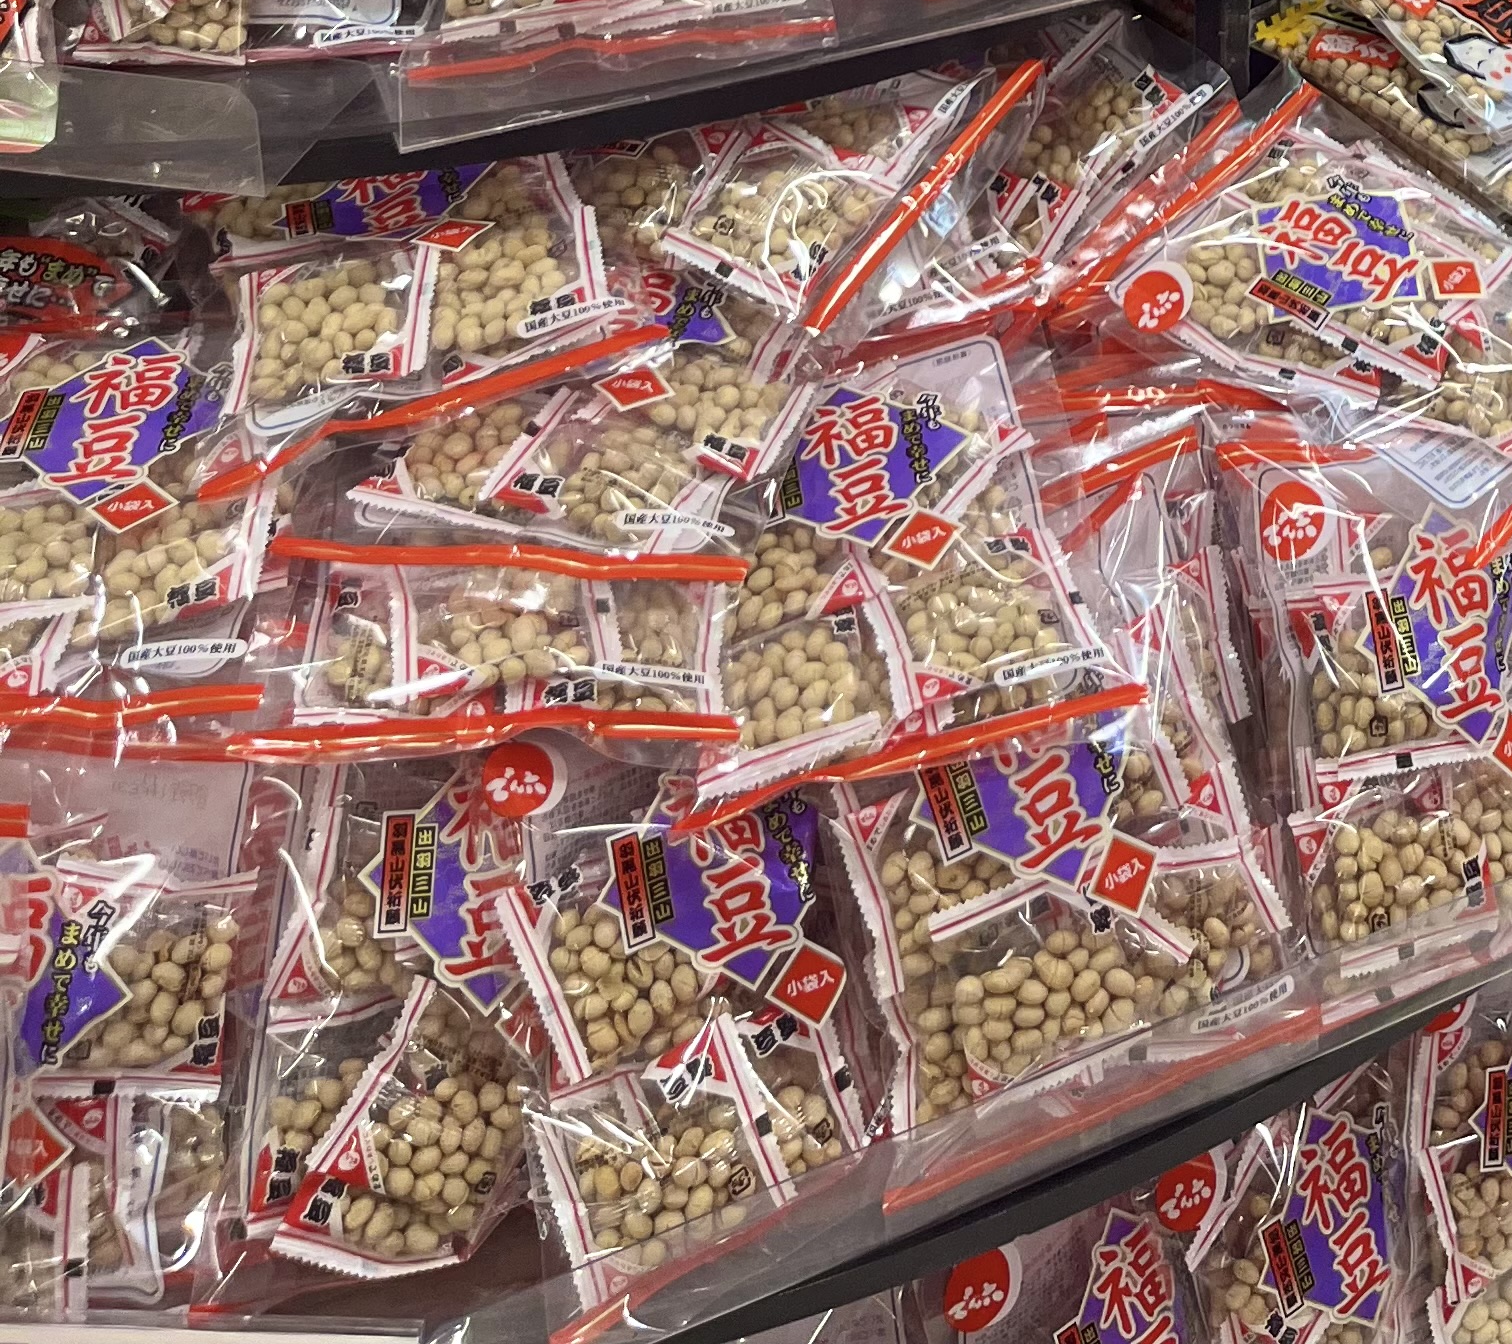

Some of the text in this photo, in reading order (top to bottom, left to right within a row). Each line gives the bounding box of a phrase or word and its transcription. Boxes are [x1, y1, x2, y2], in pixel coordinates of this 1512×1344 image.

[1262, 200, 1420, 304] 福豆
[523, 297, 626, 334] 国産大豆100%使用
[51, 352, 183, 484] 福豆
[900, 407, 933, 484] まめで幸せに
[801, 394, 910, 533] 福豆
[106, 498, 155, 514] 小袋入
[900, 527, 947, 550] 小袋入
[127, 641, 237, 663] 国産大豆100%使用
[1411, 526, 1502, 718] 福豆
[601, 662, 707, 685] 国産大豆100%使用
[1014, 751, 1103, 871] 豆
[414, 826, 436, 918] 出羽三山
[642, 835, 673, 922] 出羽三山
[1103, 857, 1147, 890] 小袋入
[41, 920, 80, 1066] まめで幸せに
[786, 969, 836, 999] 小袋入
[1197, 982, 1289, 1032] 国産大豆100%使用
[1298, 1120, 1392, 1316] 福豆
[948, 1281, 1004, 1318] でん六
[1094, 1217, 1178, 1344] 福
